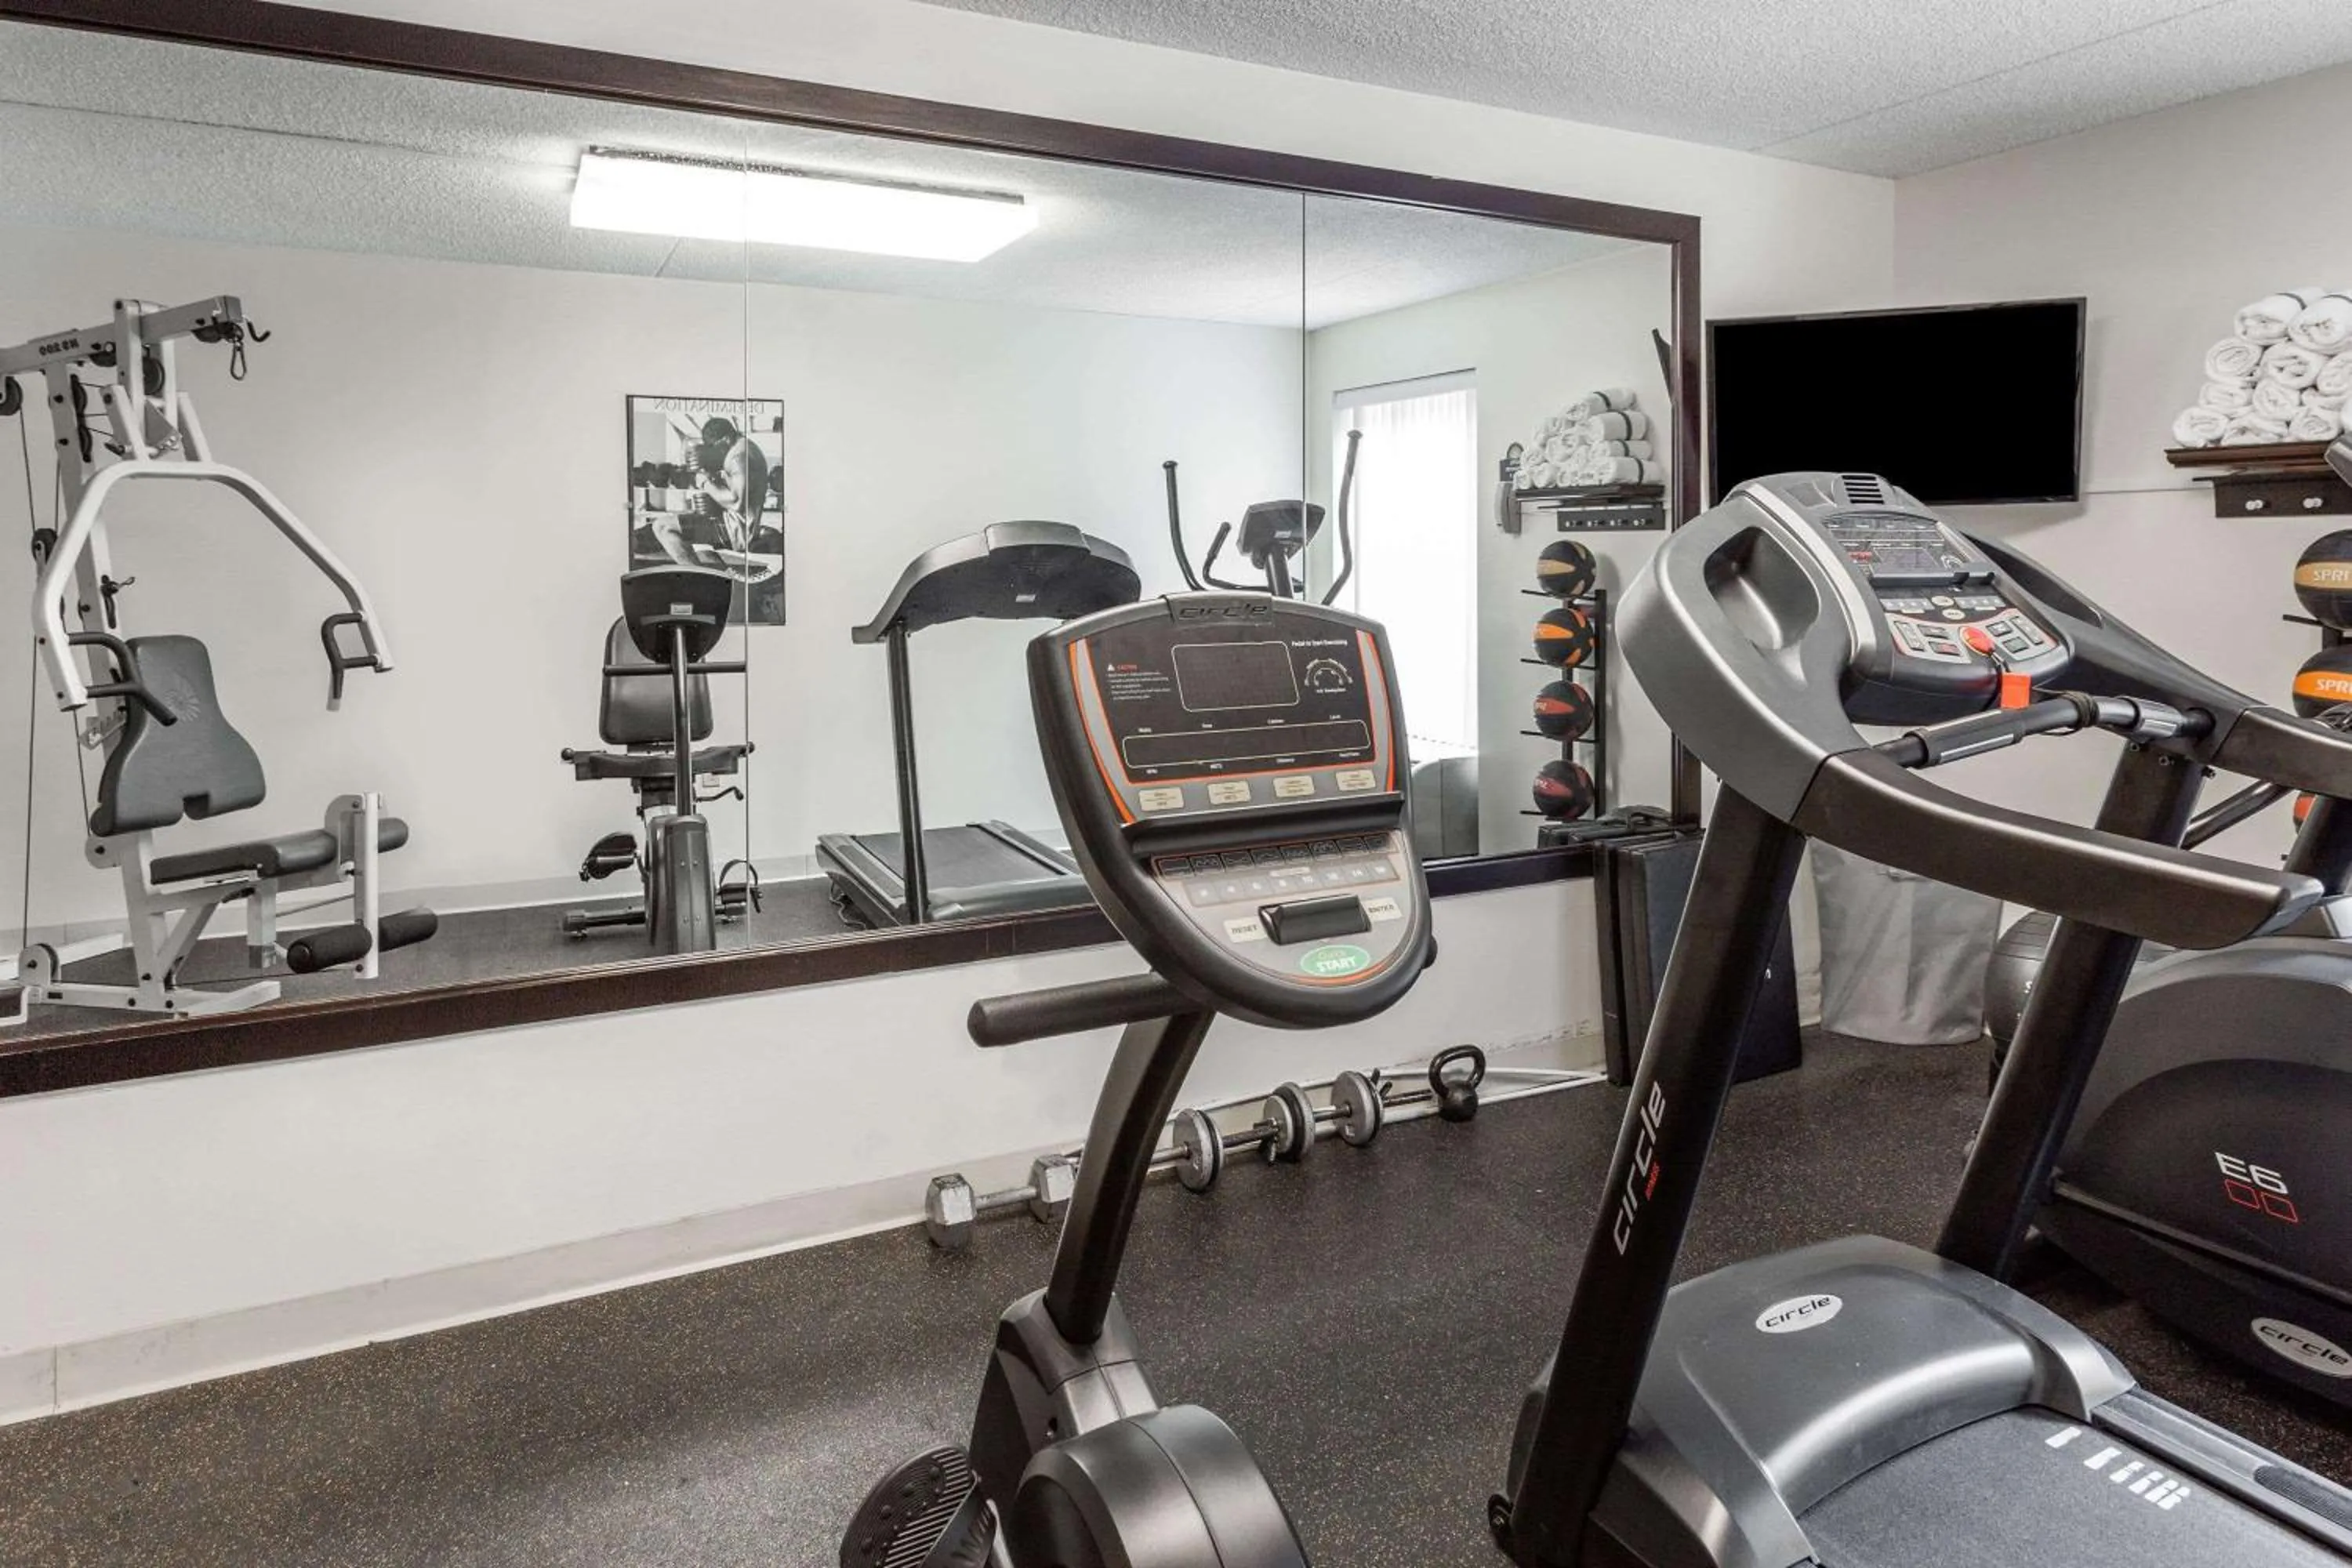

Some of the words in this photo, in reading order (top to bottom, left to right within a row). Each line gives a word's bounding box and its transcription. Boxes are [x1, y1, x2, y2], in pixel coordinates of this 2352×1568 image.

[2314, 569, 2350, 581] SPRI
[1316, 956, 1356, 972] START
[1613, 1080, 1665, 1256] circle
[2215, 1151, 2288, 1194] E6
[1766, 1297, 1831, 1327] circle
[2259, 1326, 2349, 1365] circle
